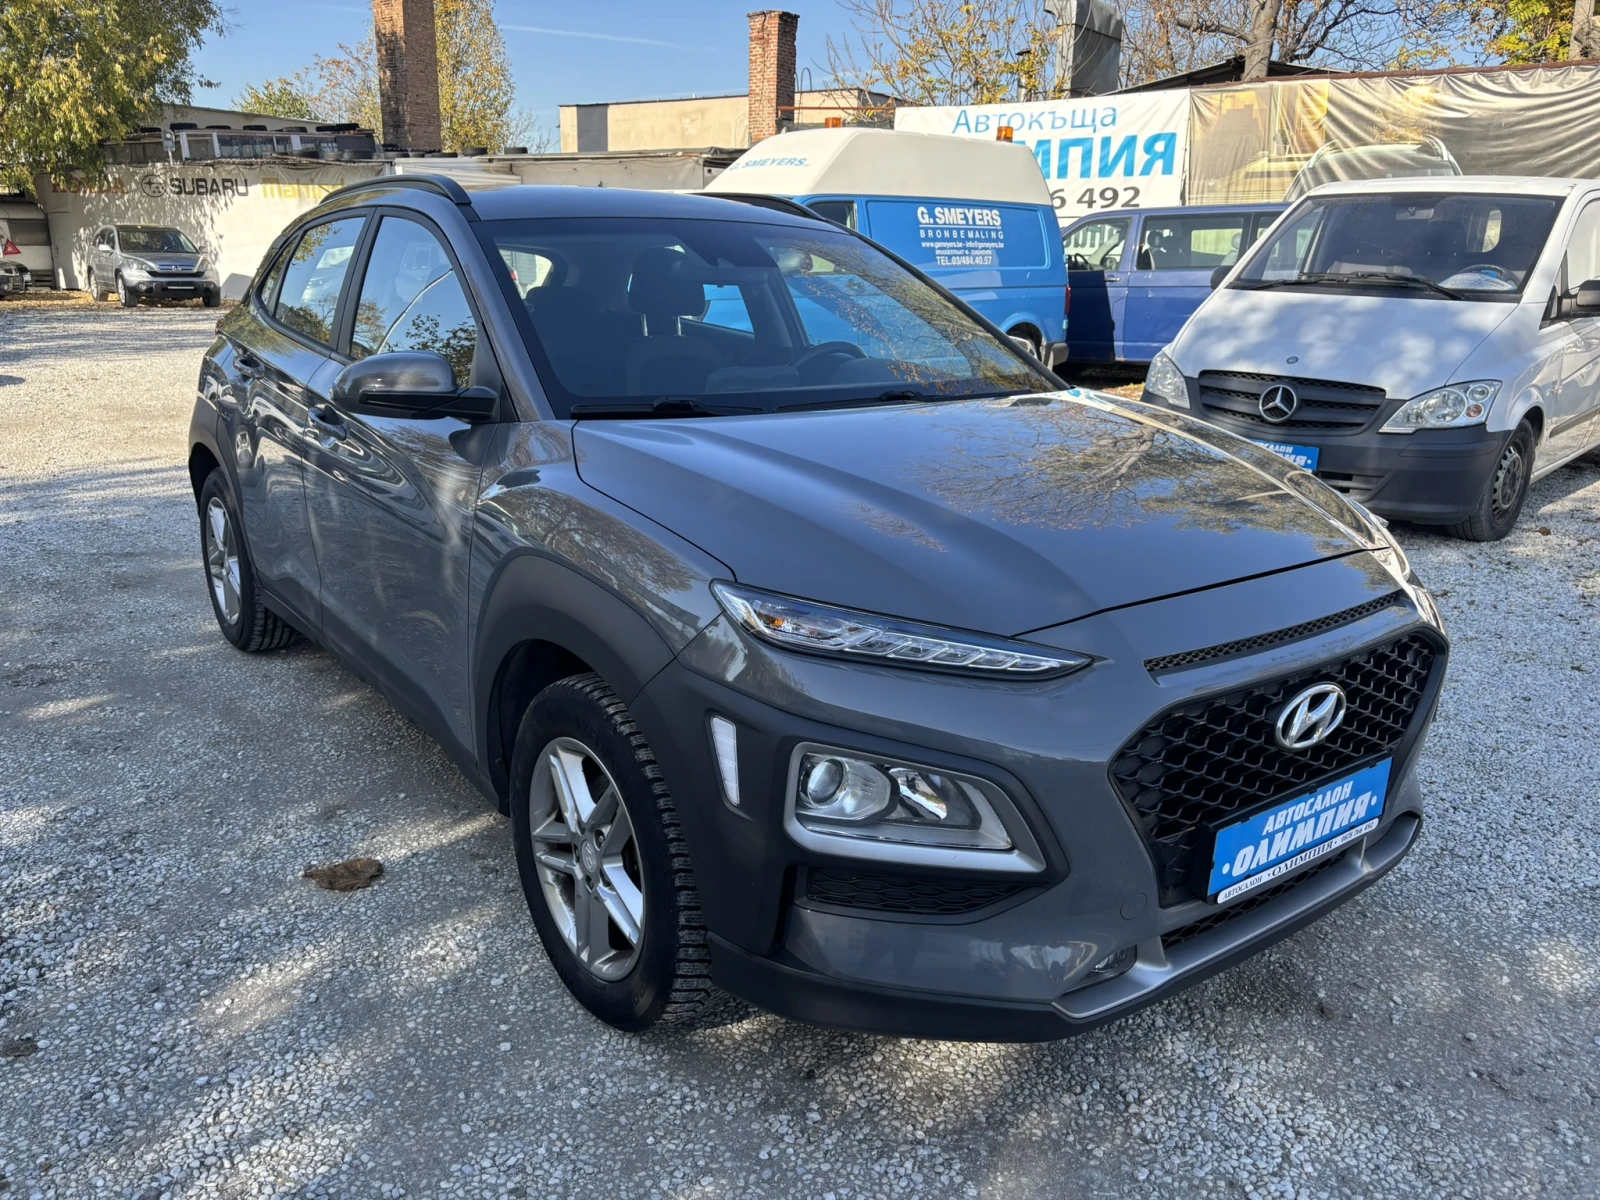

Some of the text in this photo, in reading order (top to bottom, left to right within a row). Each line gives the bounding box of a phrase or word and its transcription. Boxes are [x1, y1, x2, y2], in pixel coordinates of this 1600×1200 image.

[952, 107, 1118, 133] Автокъща
[742, 157, 807, 169] SMEYERS
[169, 177, 249, 197] SUBARU
[1076, 186, 1141, 209] 492
[917, 206, 1001, 226] G. SMEYERS
[1262, 780, 1354, 836] АВТОСАЛОН
[1231, 791, 1372, 877] ОЛИМПИЯ
[1222, 876, 1263, 900] АВТОСАЛОН
[1271, 840, 1334, 877] ОЛИМПИЯ
[1364, 821, 1375, 832] 492
